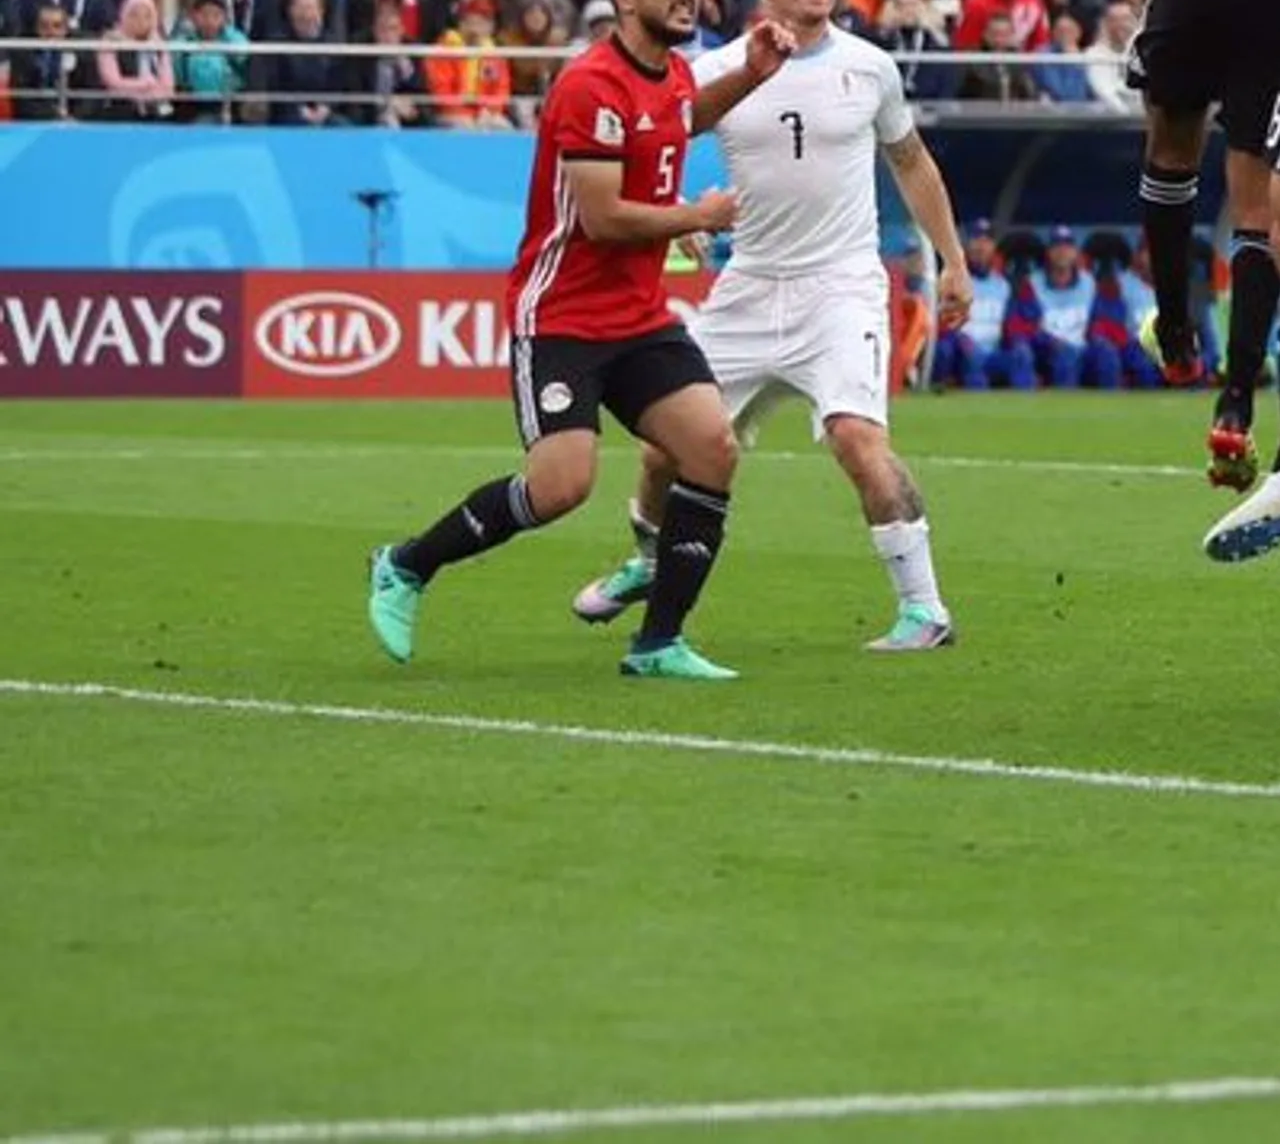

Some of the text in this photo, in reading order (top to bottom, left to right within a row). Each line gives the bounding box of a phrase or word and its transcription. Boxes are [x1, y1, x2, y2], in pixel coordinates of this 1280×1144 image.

[780, 110, 803, 160] 7
[655, 145, 677, 196] 5
[0, 295, 227, 368] WAYS
[280, 310, 376, 358] KIA
